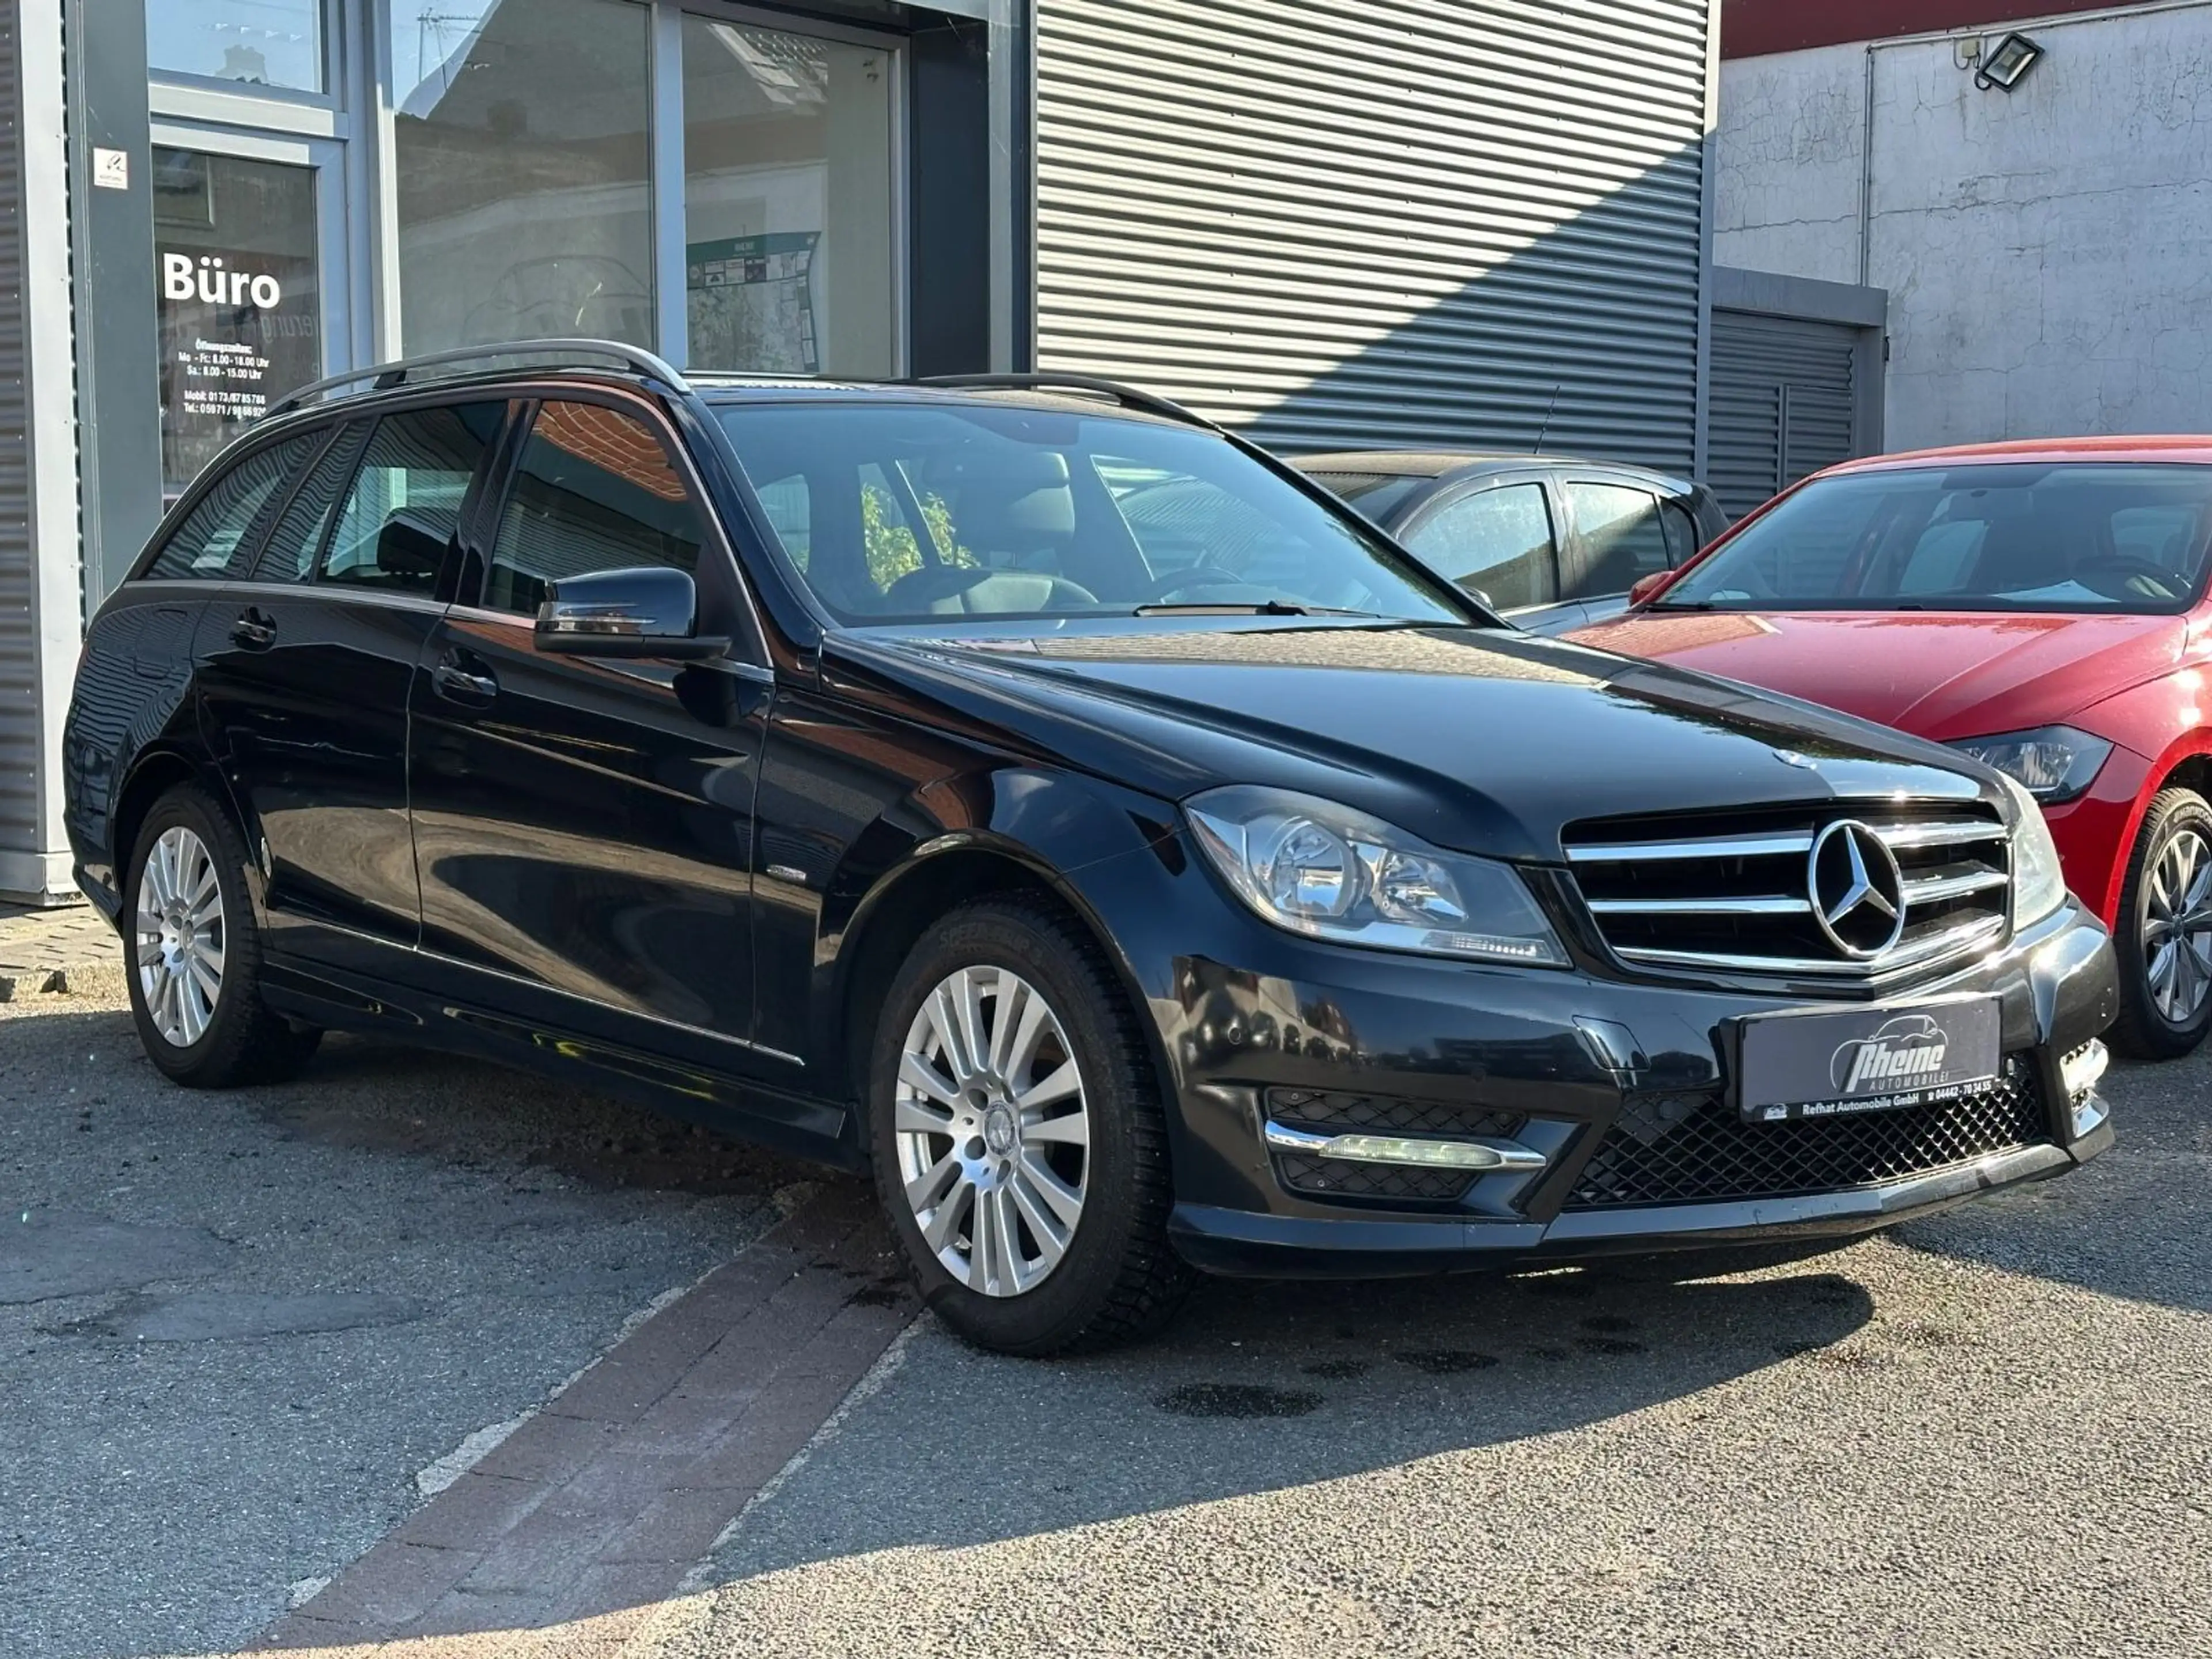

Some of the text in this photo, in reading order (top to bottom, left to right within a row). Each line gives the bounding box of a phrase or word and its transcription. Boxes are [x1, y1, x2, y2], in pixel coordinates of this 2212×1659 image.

[163, 252, 281, 309] Büro
[256, 357, 270, 368] Uhr
[249, 370, 262, 380] Uhr
[1836, 1096, 1892, 1113] Automobile
[1893, 1093, 1919, 1107] GmbH
